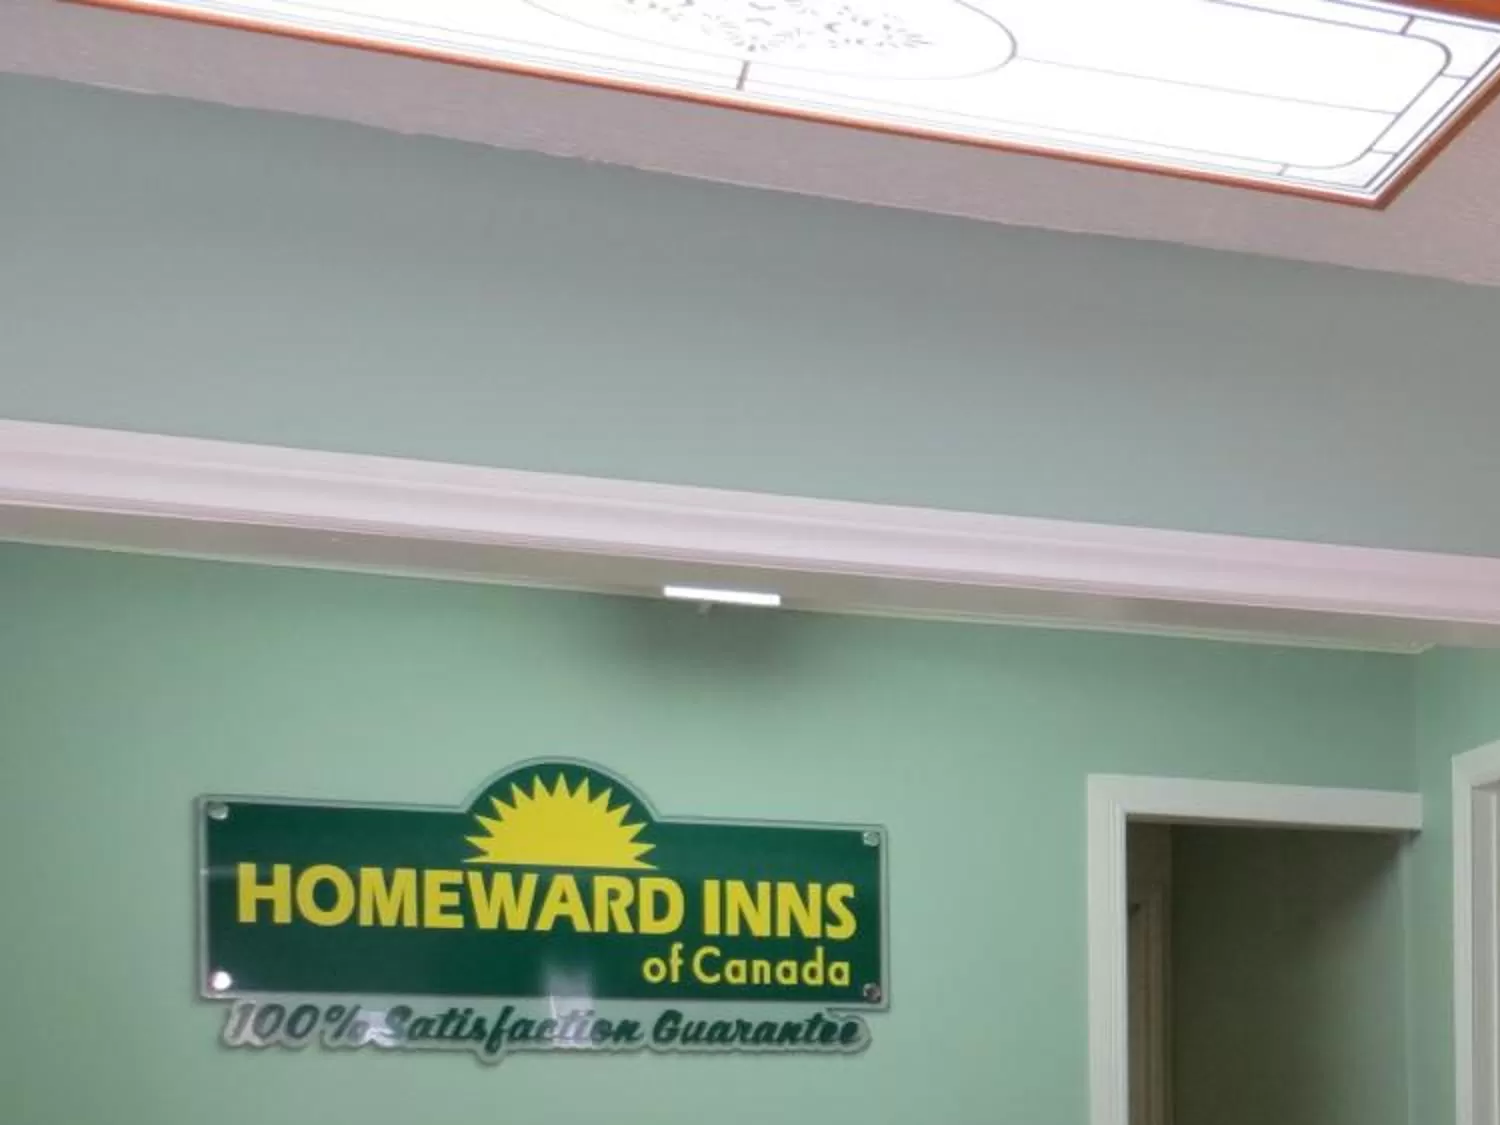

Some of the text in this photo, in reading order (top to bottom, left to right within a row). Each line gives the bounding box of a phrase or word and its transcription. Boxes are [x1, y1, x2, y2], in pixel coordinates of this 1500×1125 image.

[236, 861, 859, 940] HOMEWARD INNS
[642, 942, 851, 987] of Canada
[231, 1001, 864, 1056] 100% Satisfaction Guarantee
